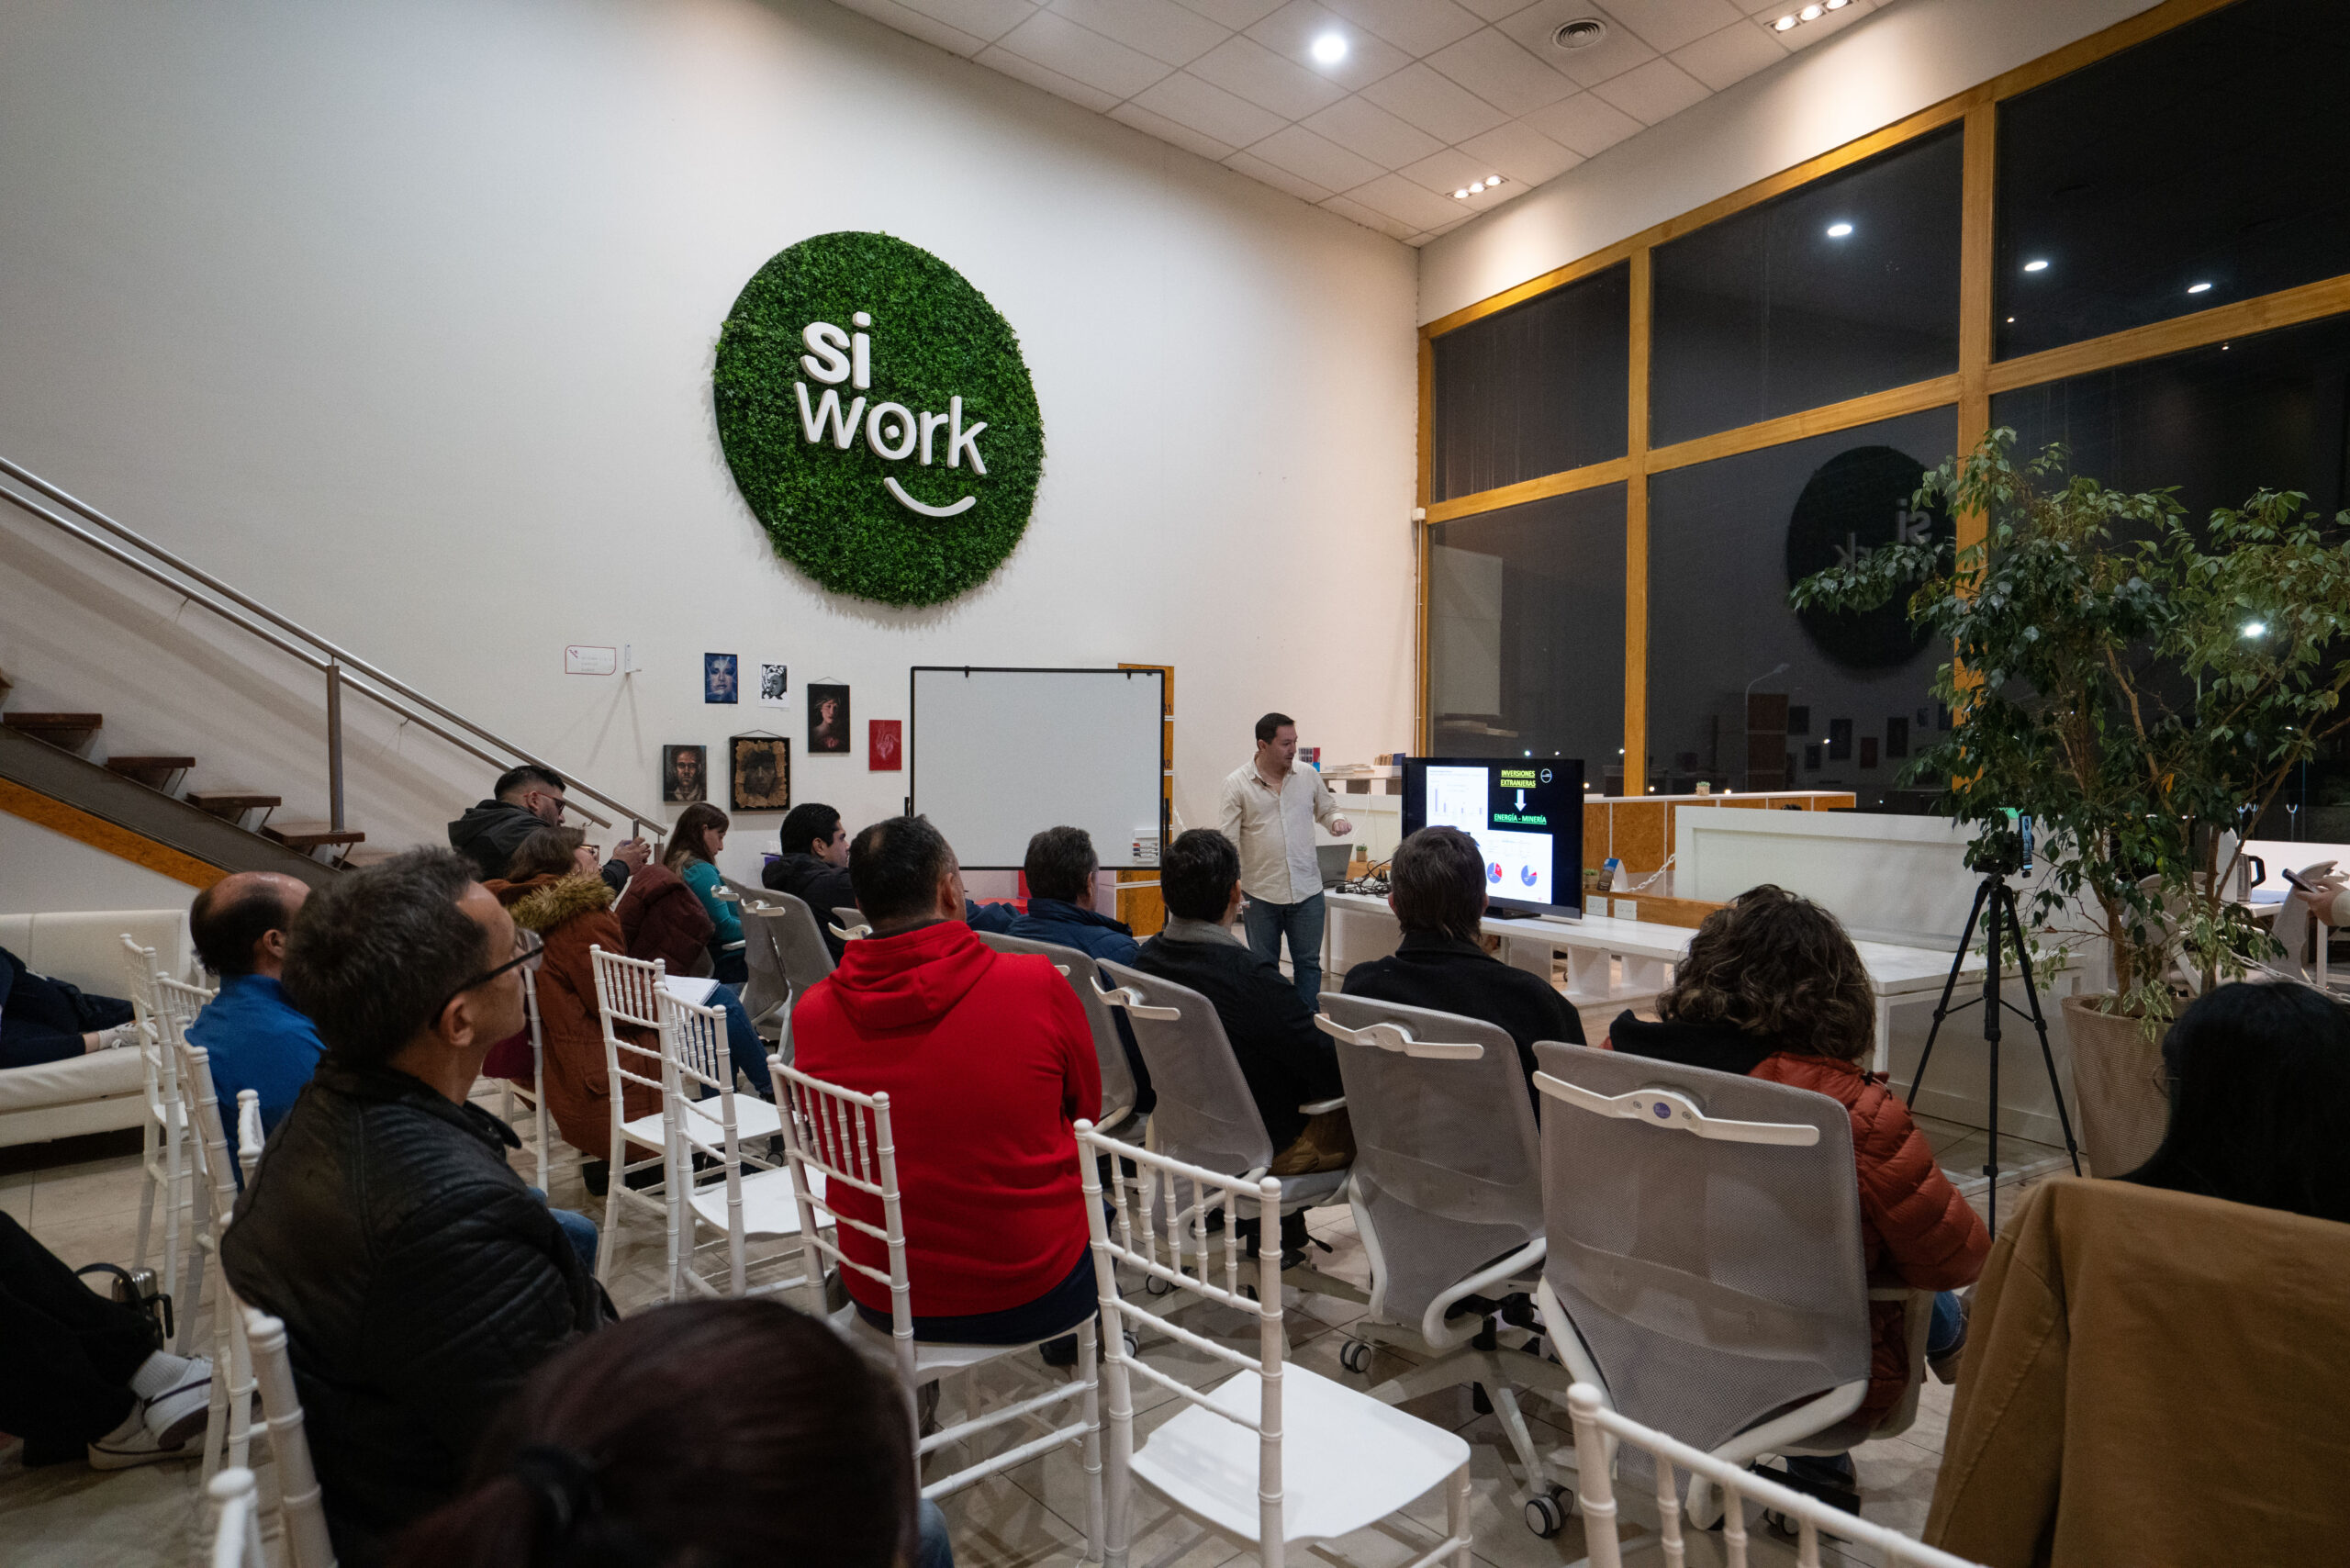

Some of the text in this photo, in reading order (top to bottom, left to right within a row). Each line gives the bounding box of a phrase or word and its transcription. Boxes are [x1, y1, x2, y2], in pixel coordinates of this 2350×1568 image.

[800, 310, 871, 390] si
[793, 381, 988, 476] work
[1501, 769, 1536, 778] INVERSIONES
[1500, 779, 1536, 788] EXTRANJERAS
[1494, 812, 1518, 823] ENERGÍA
[1521, 814, 1547, 823] MINERÍA
